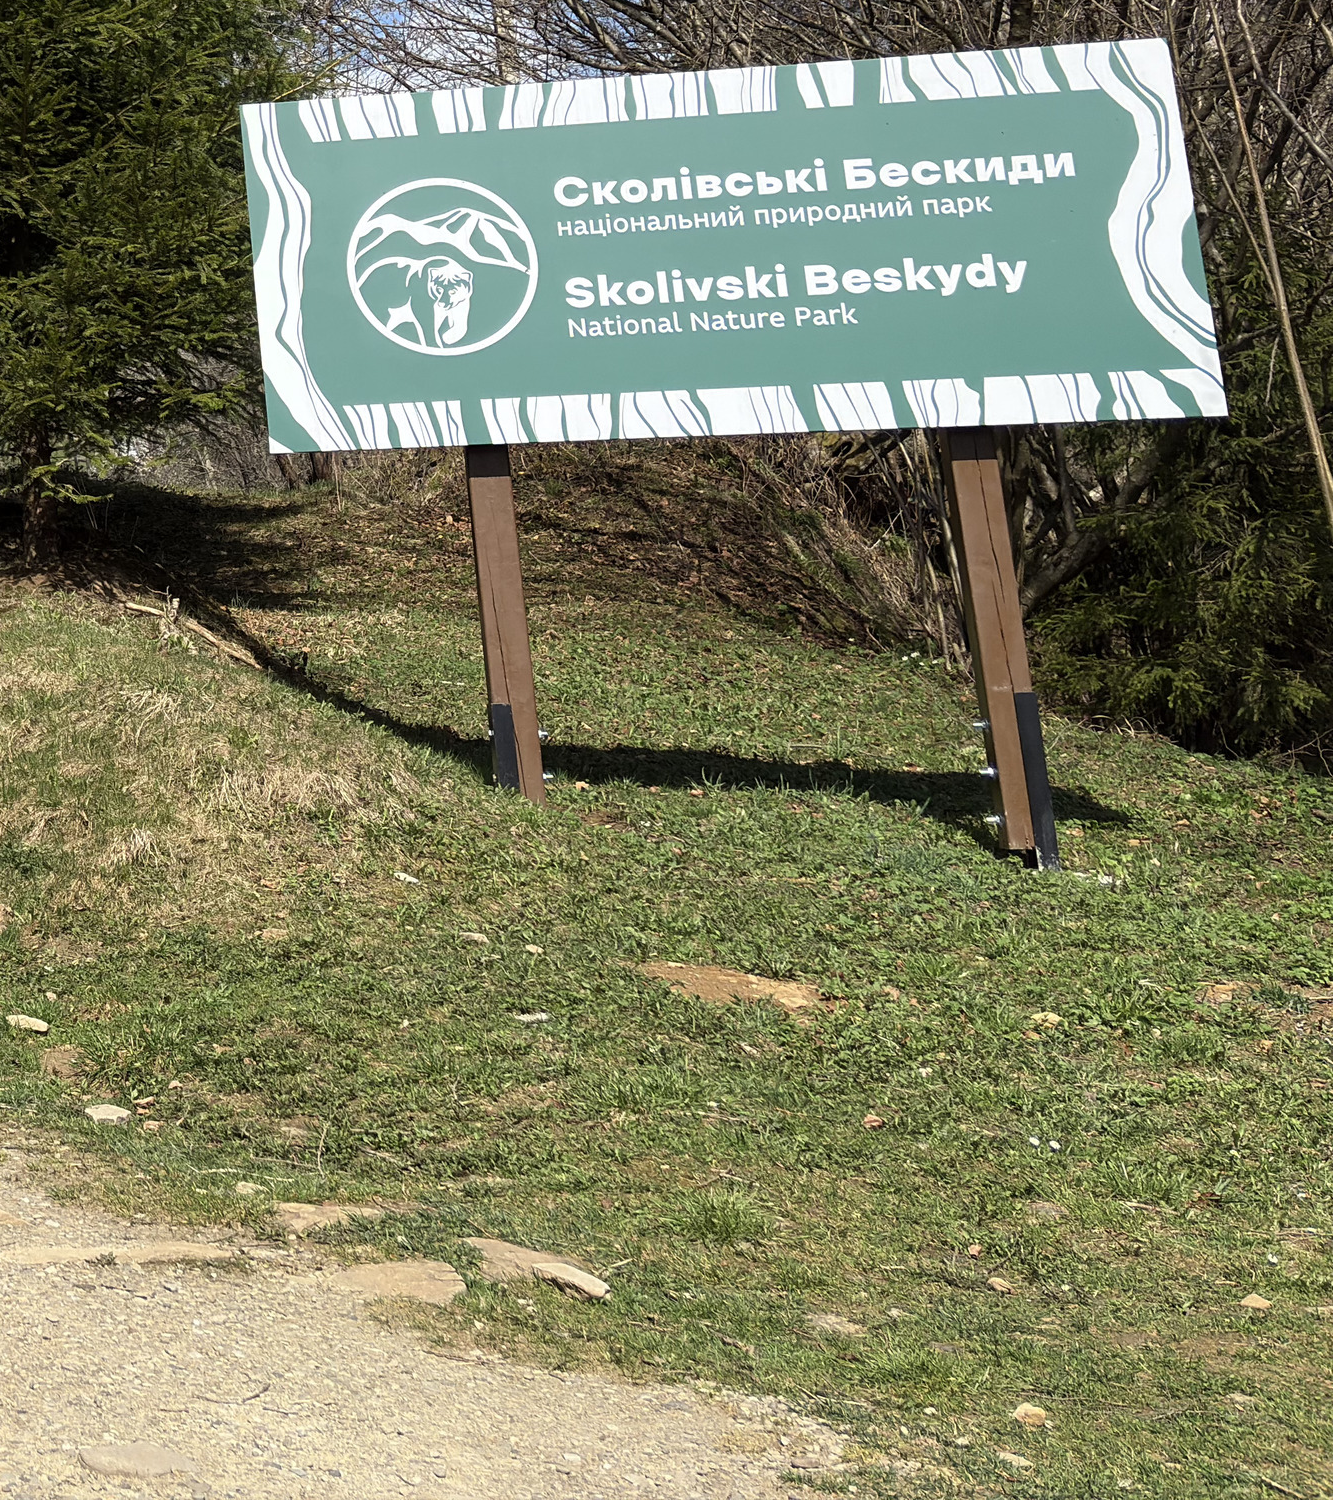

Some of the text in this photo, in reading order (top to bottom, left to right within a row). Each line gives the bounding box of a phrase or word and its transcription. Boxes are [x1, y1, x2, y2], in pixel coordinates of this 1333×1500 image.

[553, 152, 1076, 208] Сколівські Бескиди
[556, 194, 993, 237] національний природний парк
[564, 253, 1028, 309] Skolivski Beskydy
[567, 302, 859, 338] National Nature Park
